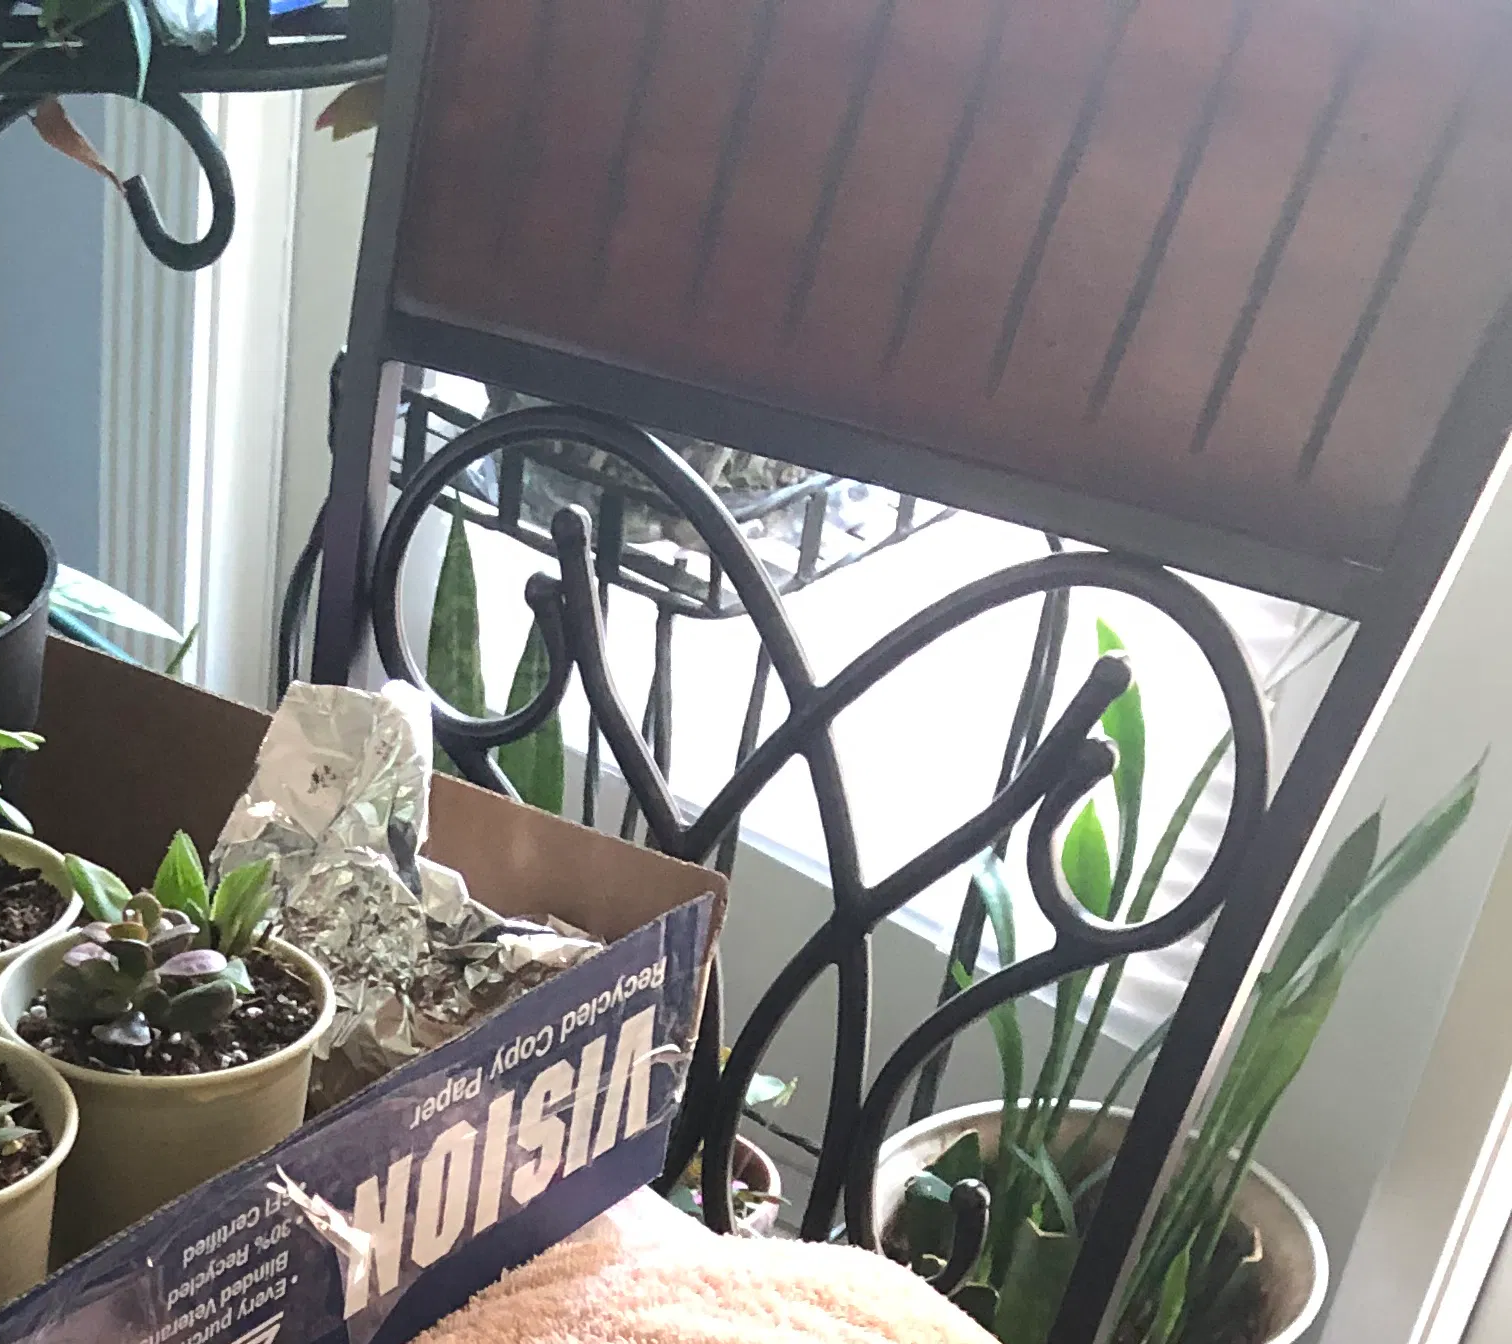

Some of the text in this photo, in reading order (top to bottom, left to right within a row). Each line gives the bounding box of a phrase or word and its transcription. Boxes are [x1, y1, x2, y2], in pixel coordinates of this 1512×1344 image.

[409, 957, 667, 1130] Recycled Copy Paper
[343, 1004, 655, 1320] VISION
[166, 1218, 292, 1311] 30% Recycled
[182, 1206, 260, 1268] Certified
[220, 1249, 288, 1303] Blinded
[236, 1277, 287, 1321] Every
